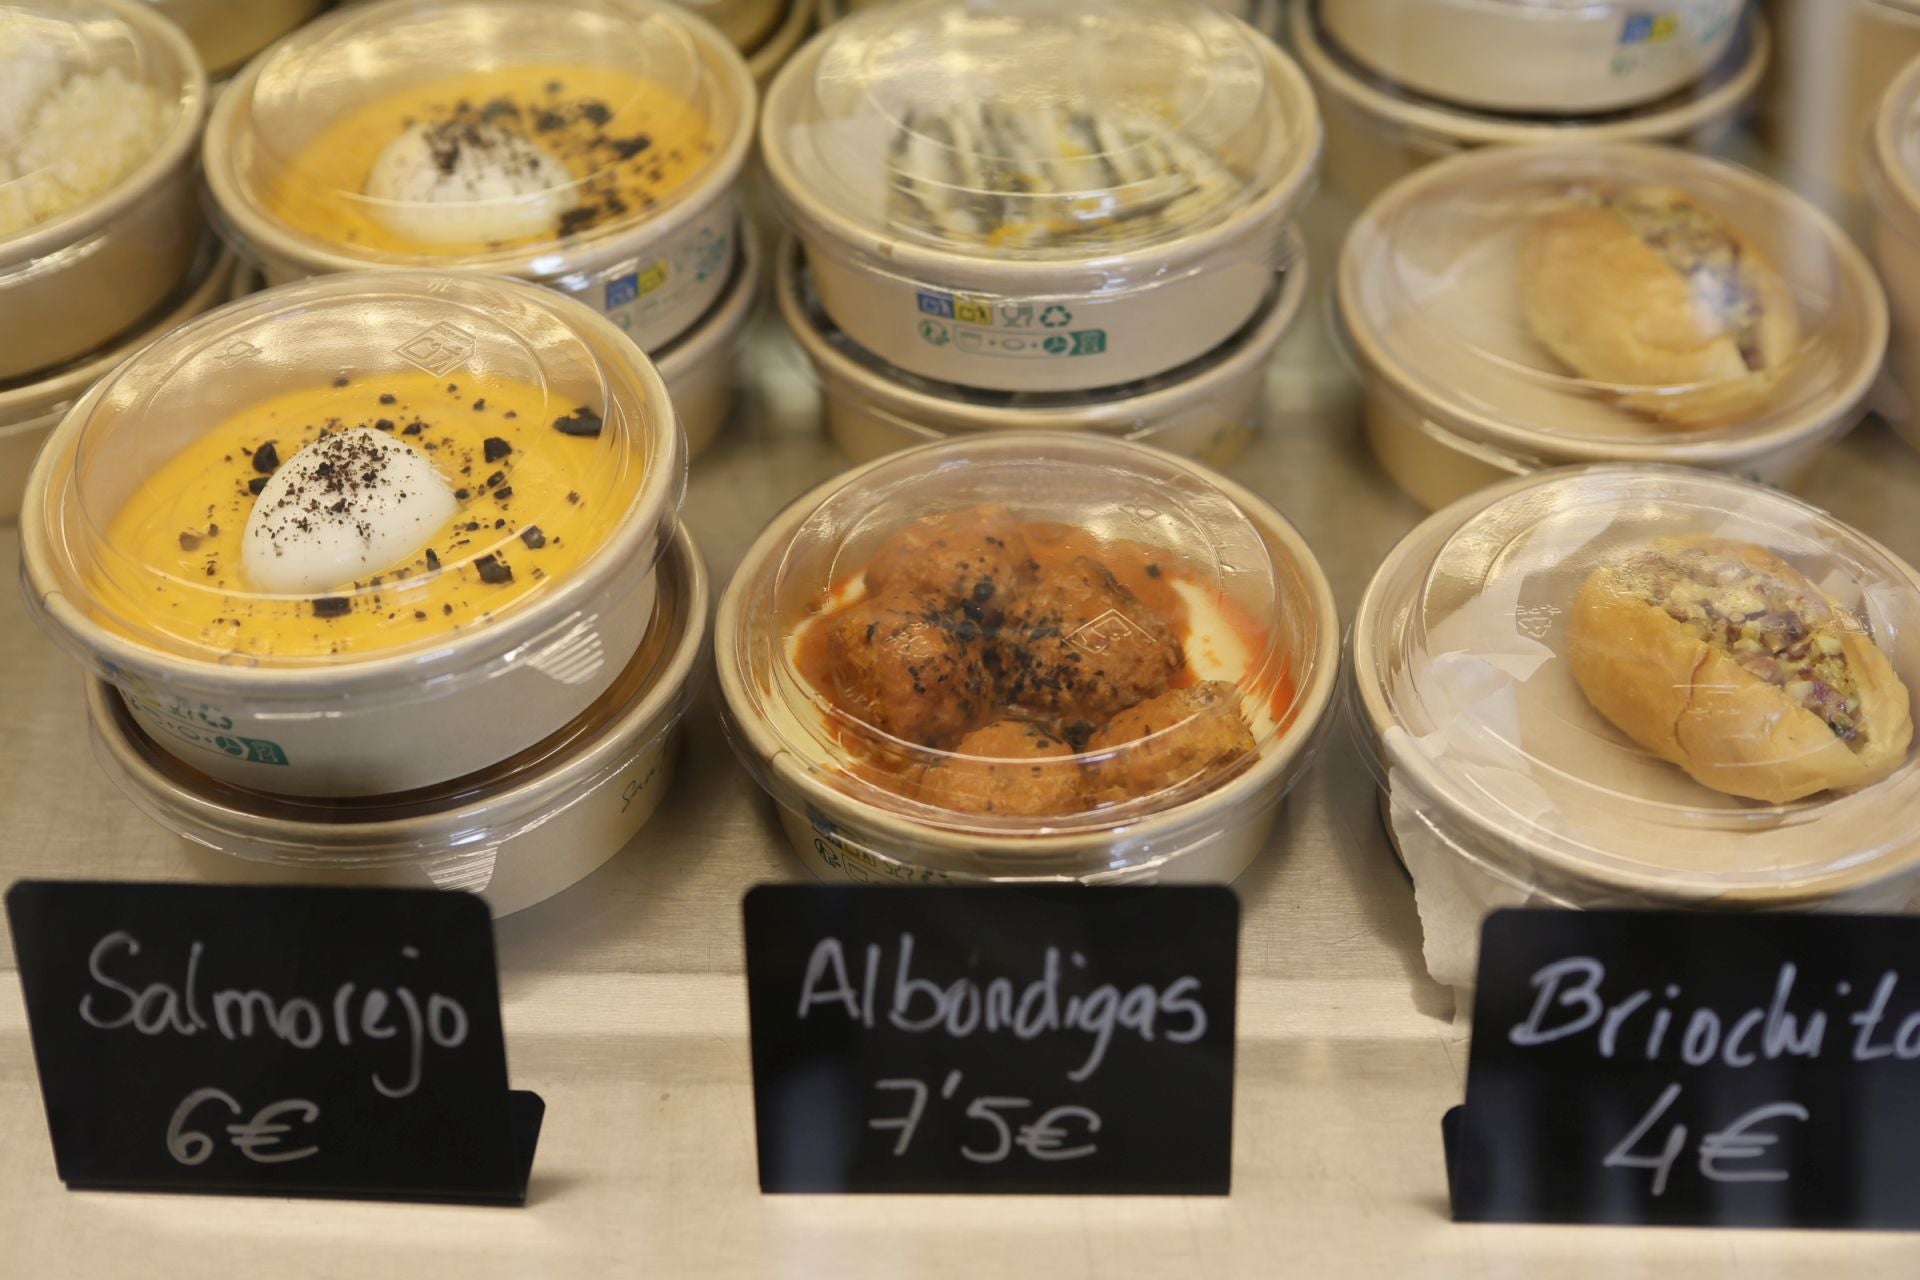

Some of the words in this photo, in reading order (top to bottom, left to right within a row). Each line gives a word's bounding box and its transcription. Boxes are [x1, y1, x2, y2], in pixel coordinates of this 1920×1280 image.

[79, 931, 468, 1098] Salmorejo
[798, 933, 1208, 1083] Albondigas
[166, 1087, 319, 1166] 6€
[1603, 1084, 1809, 1195] 4€
